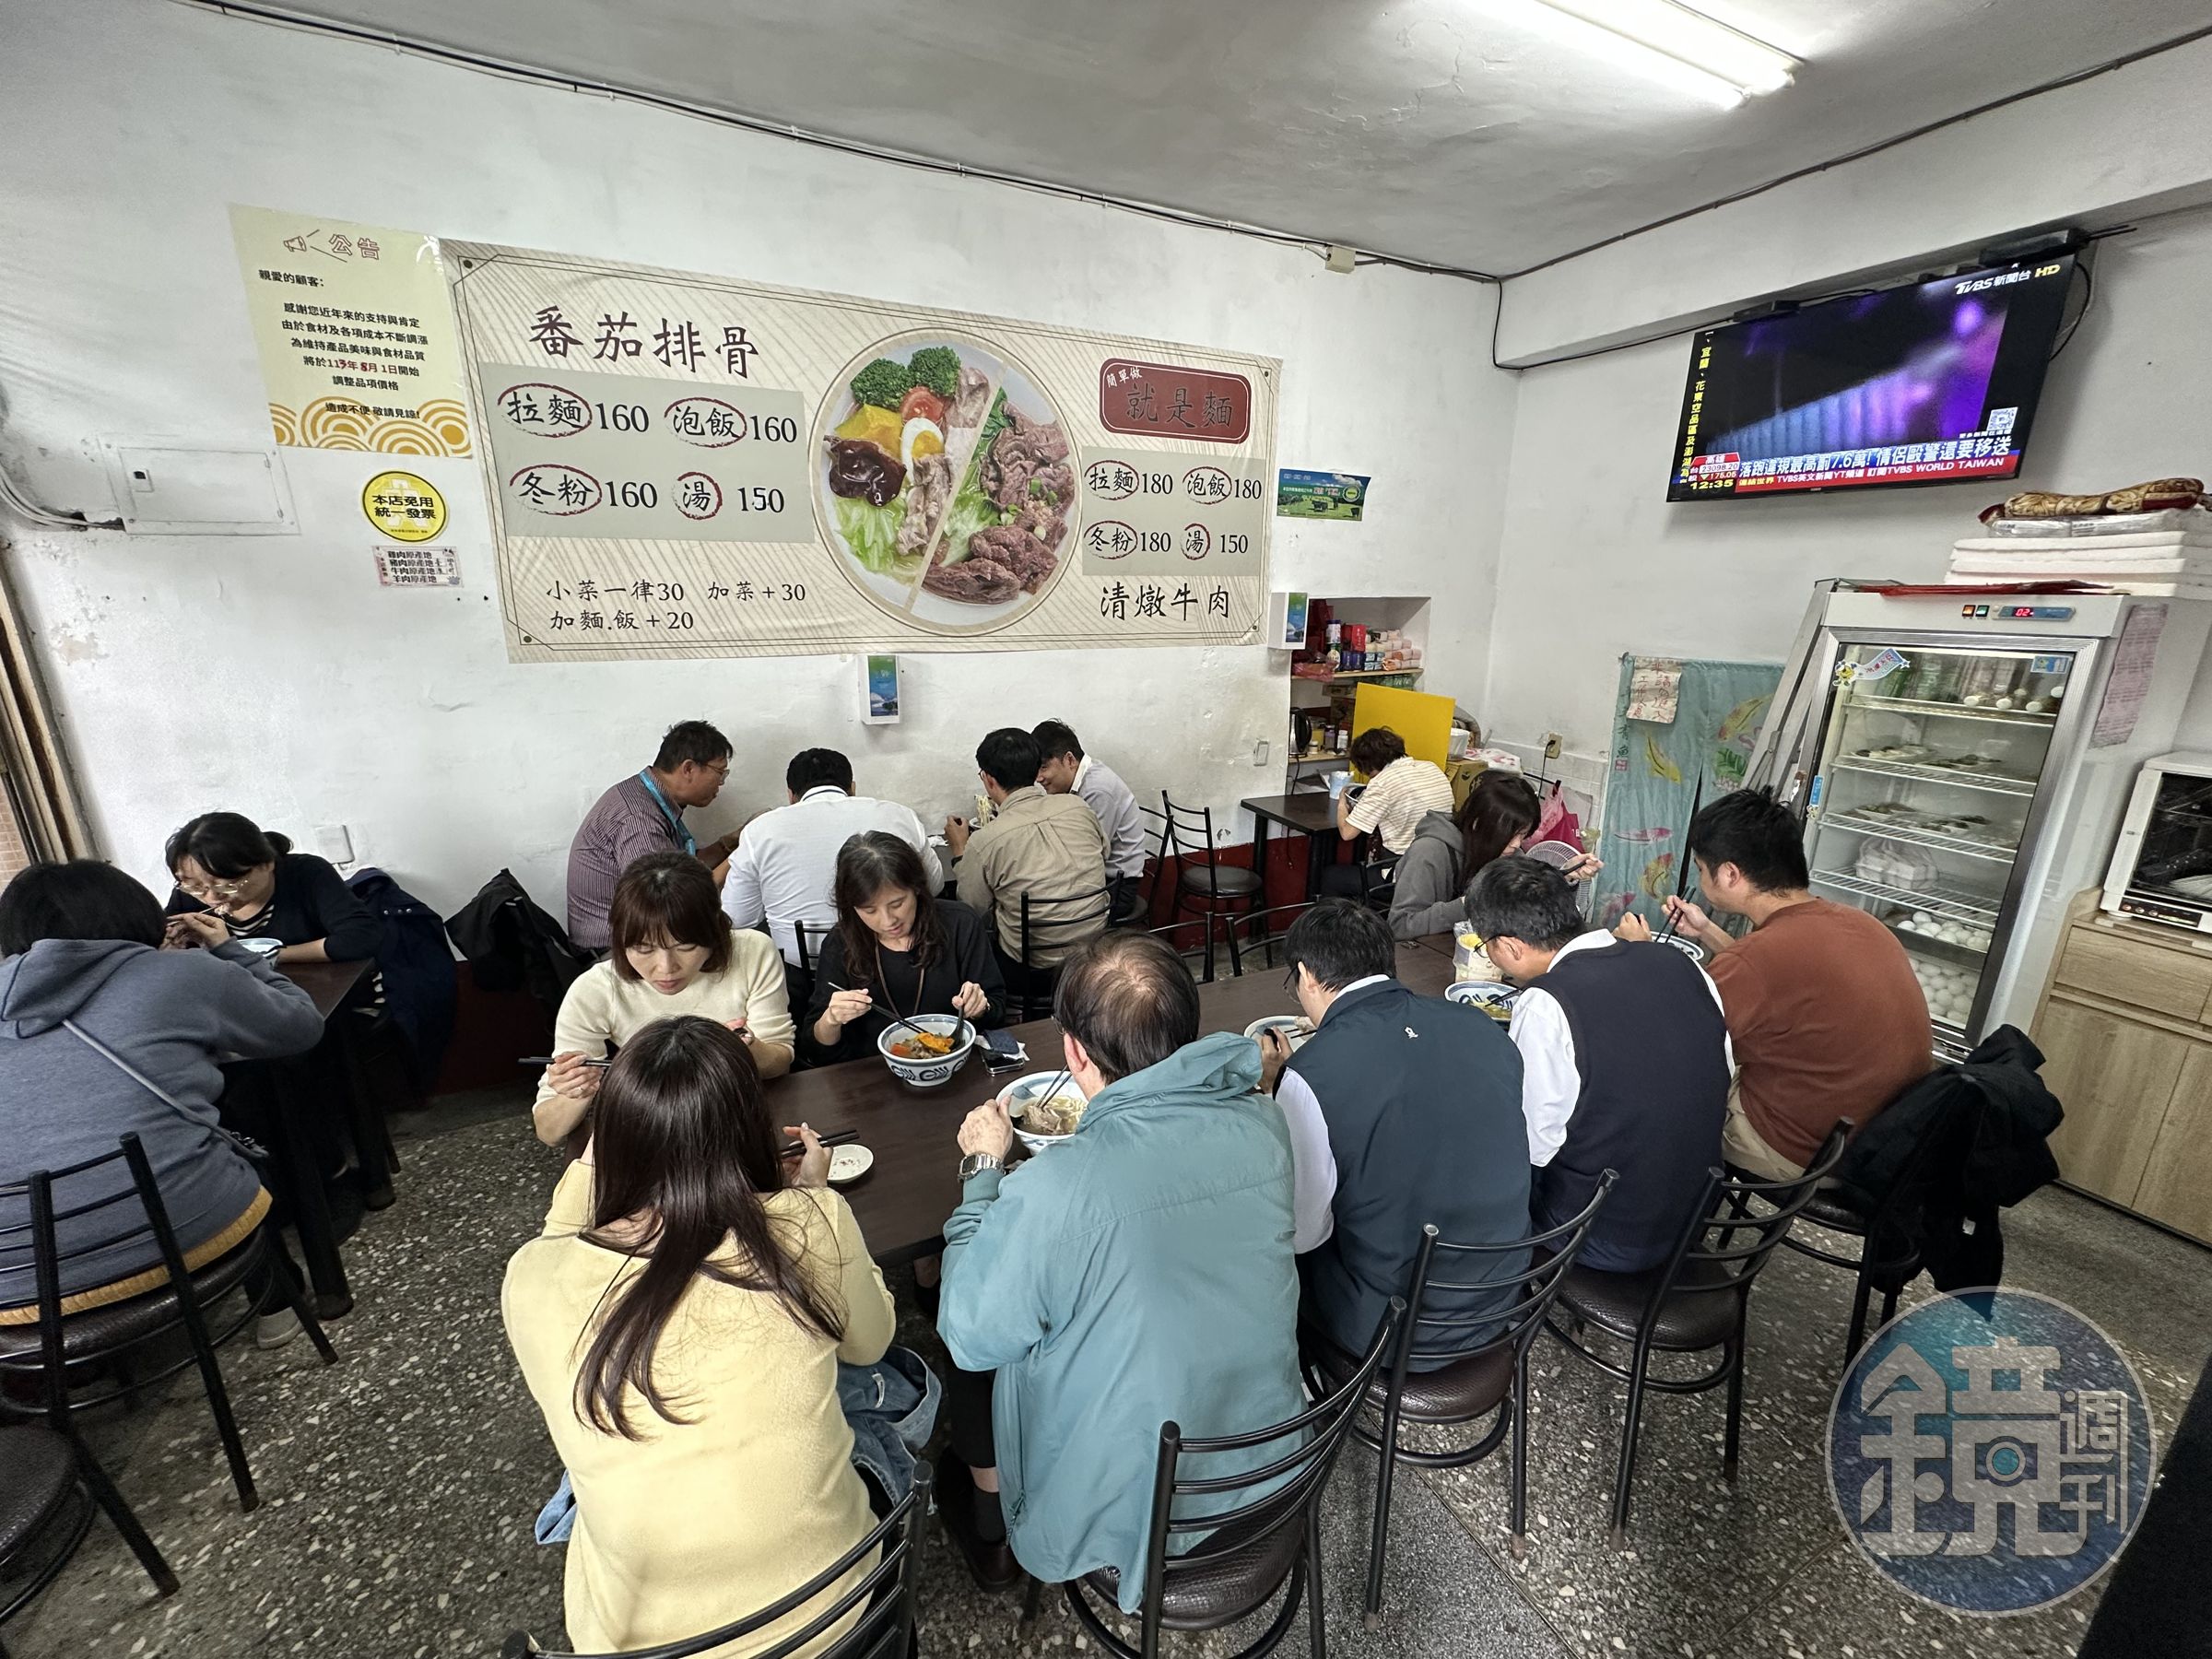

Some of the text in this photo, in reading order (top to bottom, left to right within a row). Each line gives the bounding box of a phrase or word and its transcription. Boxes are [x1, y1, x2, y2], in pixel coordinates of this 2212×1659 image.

[329, 234, 380, 260] 公告
[2034, 265, 2061, 277] HD
[283, 302, 420, 328] 感謝您近年來的支持與肯定
[281, 320, 429, 346] 由於食材及各項成本不斷調漲
[529, 305, 759, 379] 番茄排骨
[290, 337, 425, 361] 為維持產品美味與食材品質
[332, 375, 399, 391] 調整品項價格
[1106, 367, 1143, 388] 簡單做
[325, 402, 370, 415] 造成不便
[507, 392, 650, 432] 拉麵 160
[1126, 382, 1233, 429] 就是麵
[673, 406, 797, 443] 泡飯 160
[1916, 462, 1954, 473] WORLD
[1958, 458, 2005, 469] TAIWAN
[518, 472, 657, 509] 冬粉 160
[1088, 467, 1173, 495] 拉麵 180
[1186, 473, 1262, 500] 泡飯 180
[1689, 479, 1734, 490] 12:35
[372, 494, 434, 508] 本店免用
[682, 481, 785, 513] 湯 150
[374, 507, 436, 519] 統一發票
[1088, 527, 1171, 553] 冬粉 180
[1185, 529, 1249, 554] 湯 150
[1100, 581, 1230, 621] 清燉牛肉
